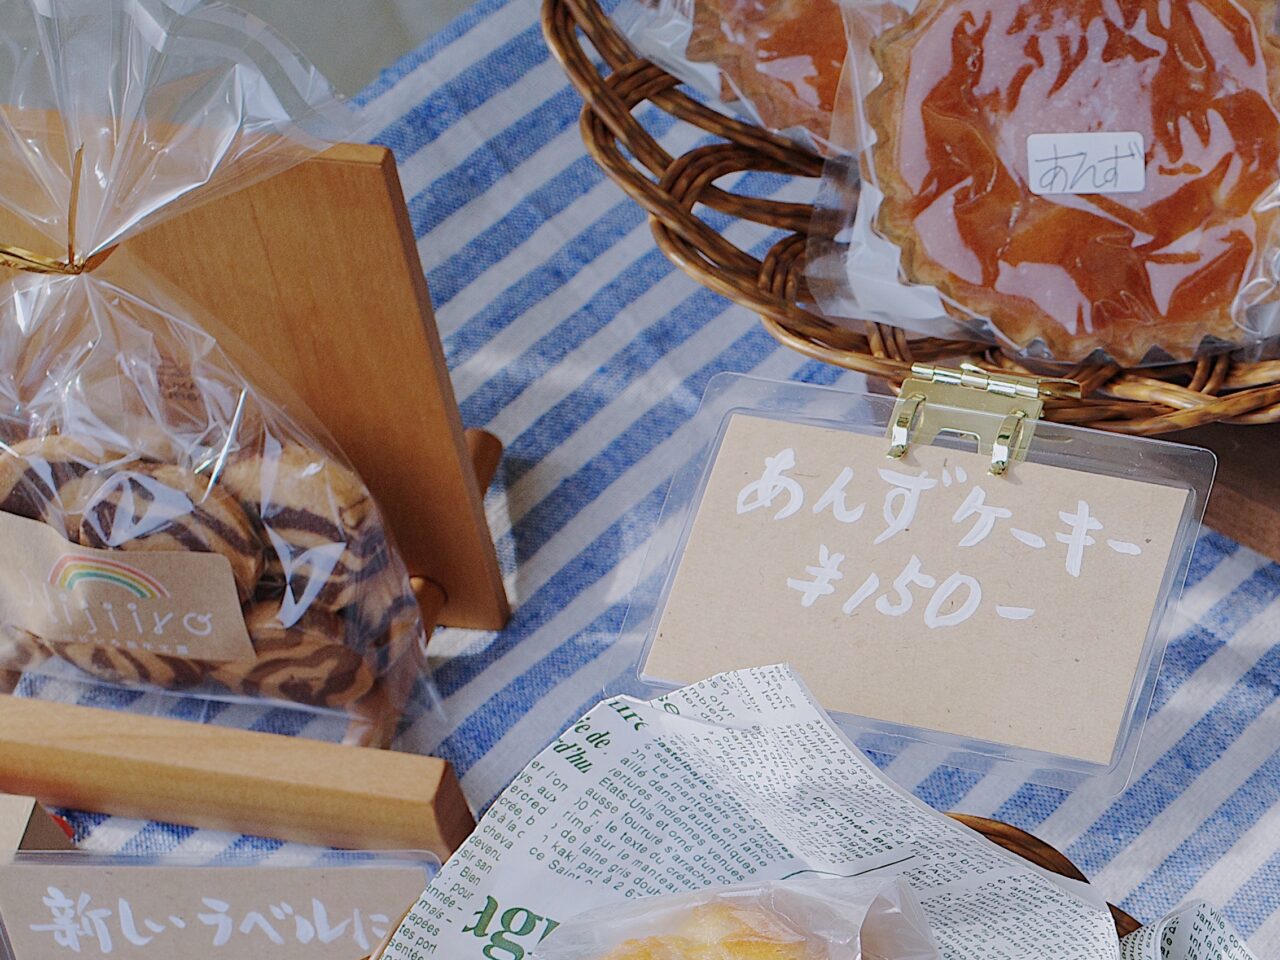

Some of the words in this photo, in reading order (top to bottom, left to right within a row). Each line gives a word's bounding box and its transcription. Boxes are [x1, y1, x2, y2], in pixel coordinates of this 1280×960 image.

[736, 447, 1143, 577] あんずケーキー
[483, 825, 513, 849] cheva
[599, 777, 654, 820] Etats-Unis
[669, 831, 694, 852] orné
[693, 855, 716, 874] d'un
[620, 832, 647, 853] texte
[649, 780, 676, 802] dans
[677, 805, 756, 874] d'authentiques
[655, 800, 705, 846] indiennes
[708, 848, 745, 881] venues
[671, 782, 720, 824] manteau
[740, 842, 767, 866] laine
[526, 844, 547, 863] ce
[552, 841, 578, 862] kaki
[577, 862, 603, 878] part
[594, 835, 616, 851] sur
[460, 866, 480, 885] Bien
[579, 842, 607, 864] laine
[608, 864, 631, 885] gris
[665, 847, 711, 885] s'arrache
[419, 900, 444, 919] mais
[450, 883, 474, 900] pour
